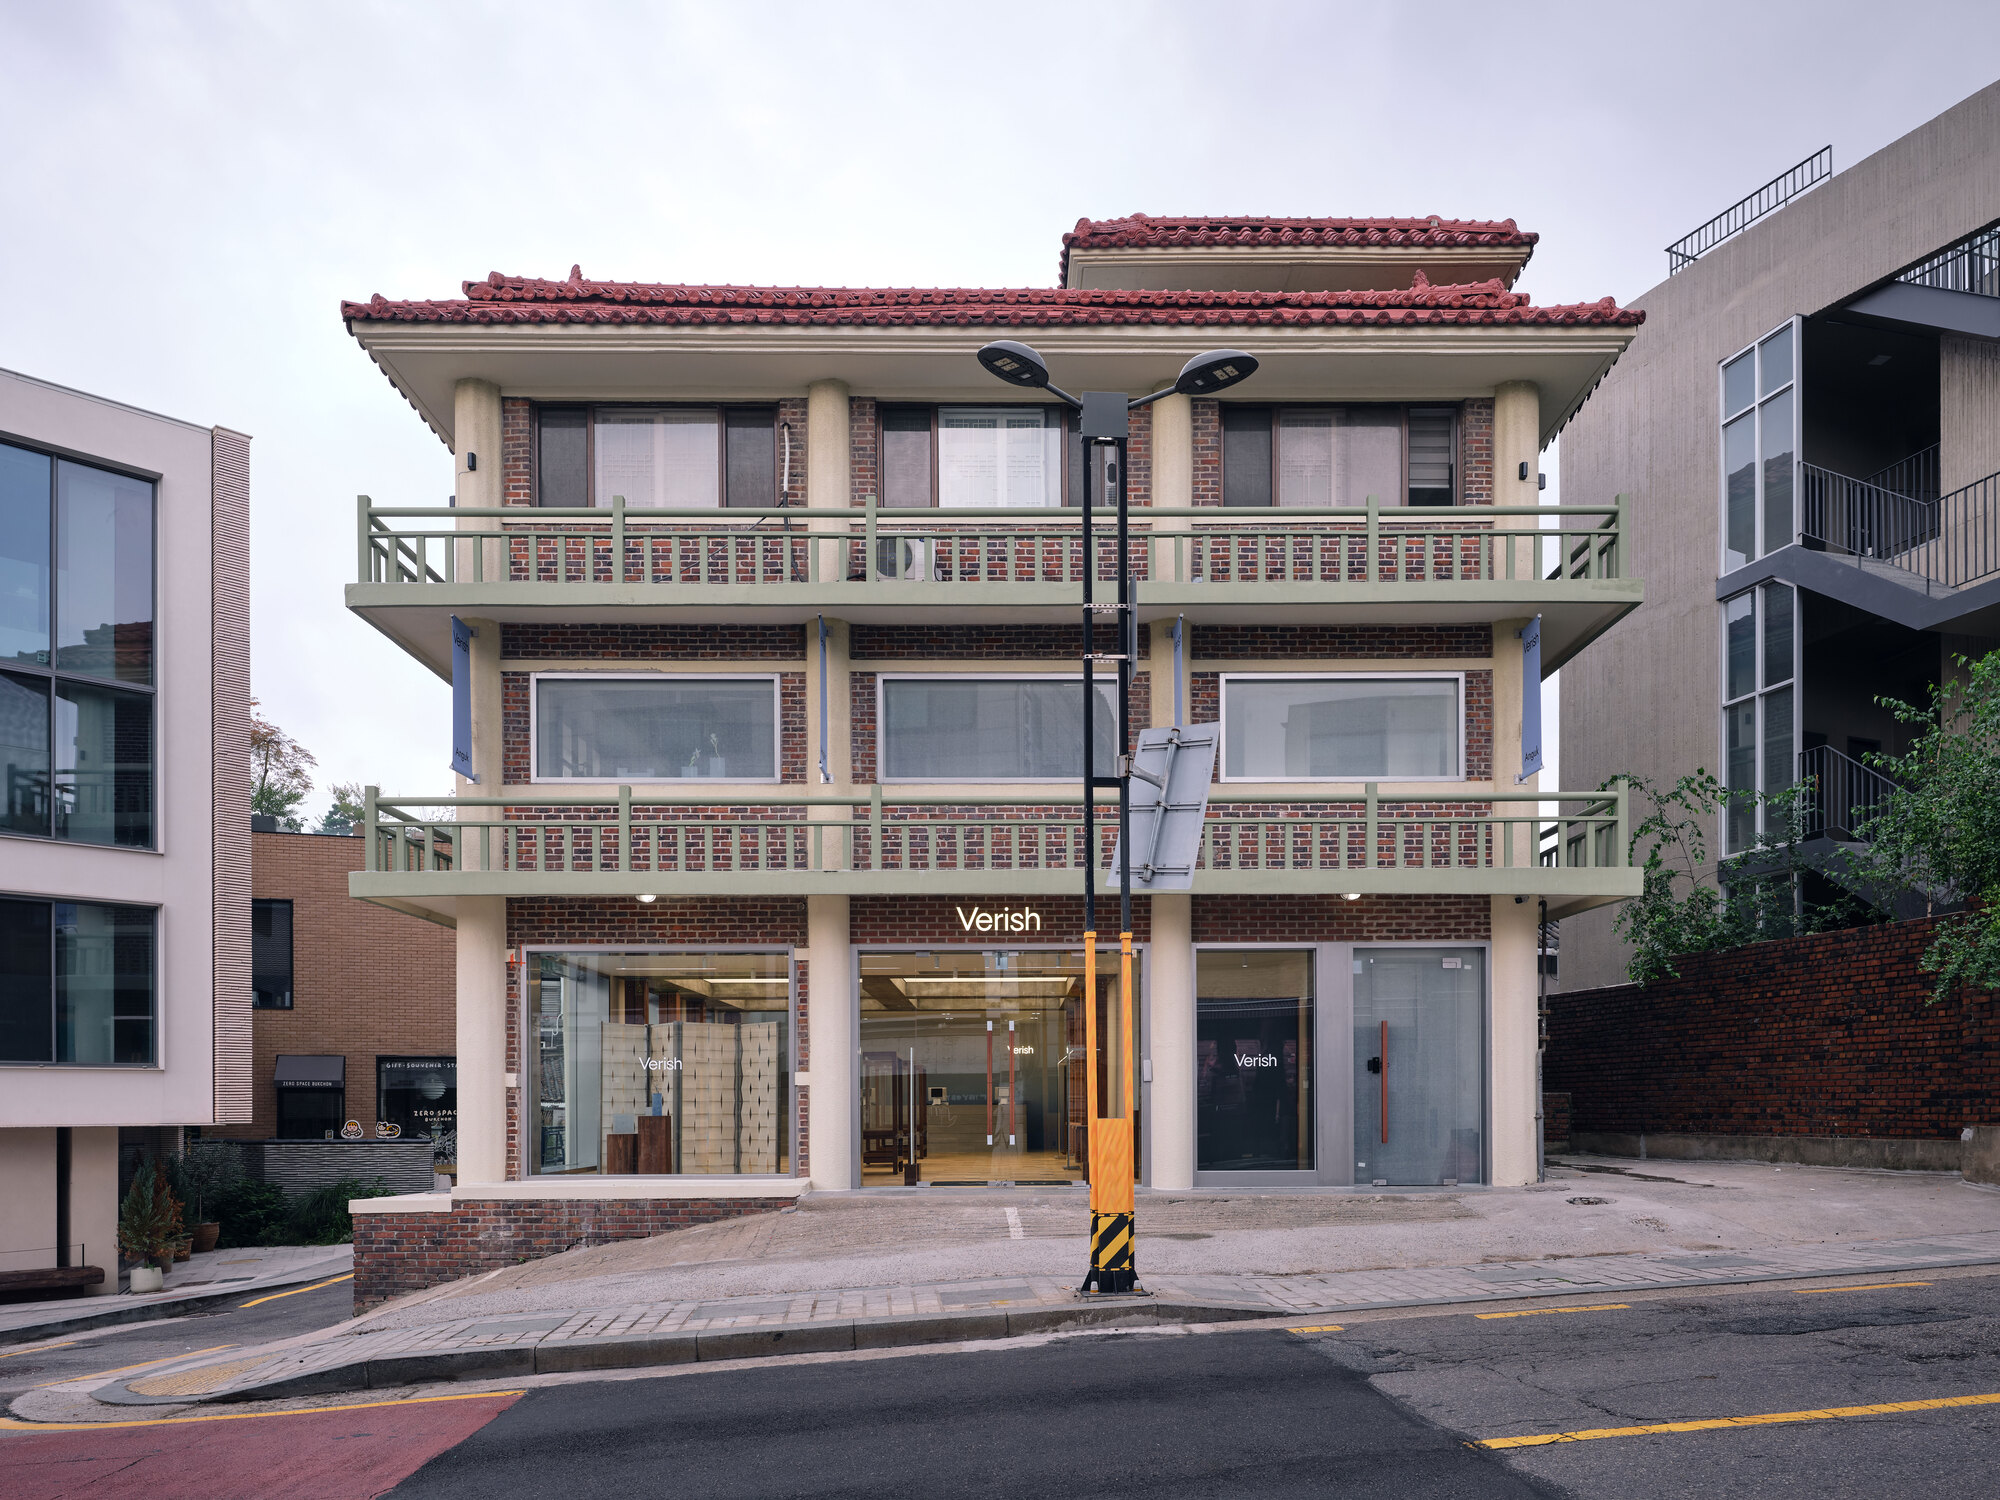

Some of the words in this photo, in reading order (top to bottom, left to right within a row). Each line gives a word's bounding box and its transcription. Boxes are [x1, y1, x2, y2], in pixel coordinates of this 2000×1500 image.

[453, 630, 469, 656] Verish
[1523, 634, 1539, 654] Verish
[455, 747, 470, 762] Anguk
[1524, 746, 1539, 762] Anguk
[956, 906, 1041, 932] Verish
[639, 1056, 682, 1070] Verish
[1234, 1053, 1277, 1067] Verish
